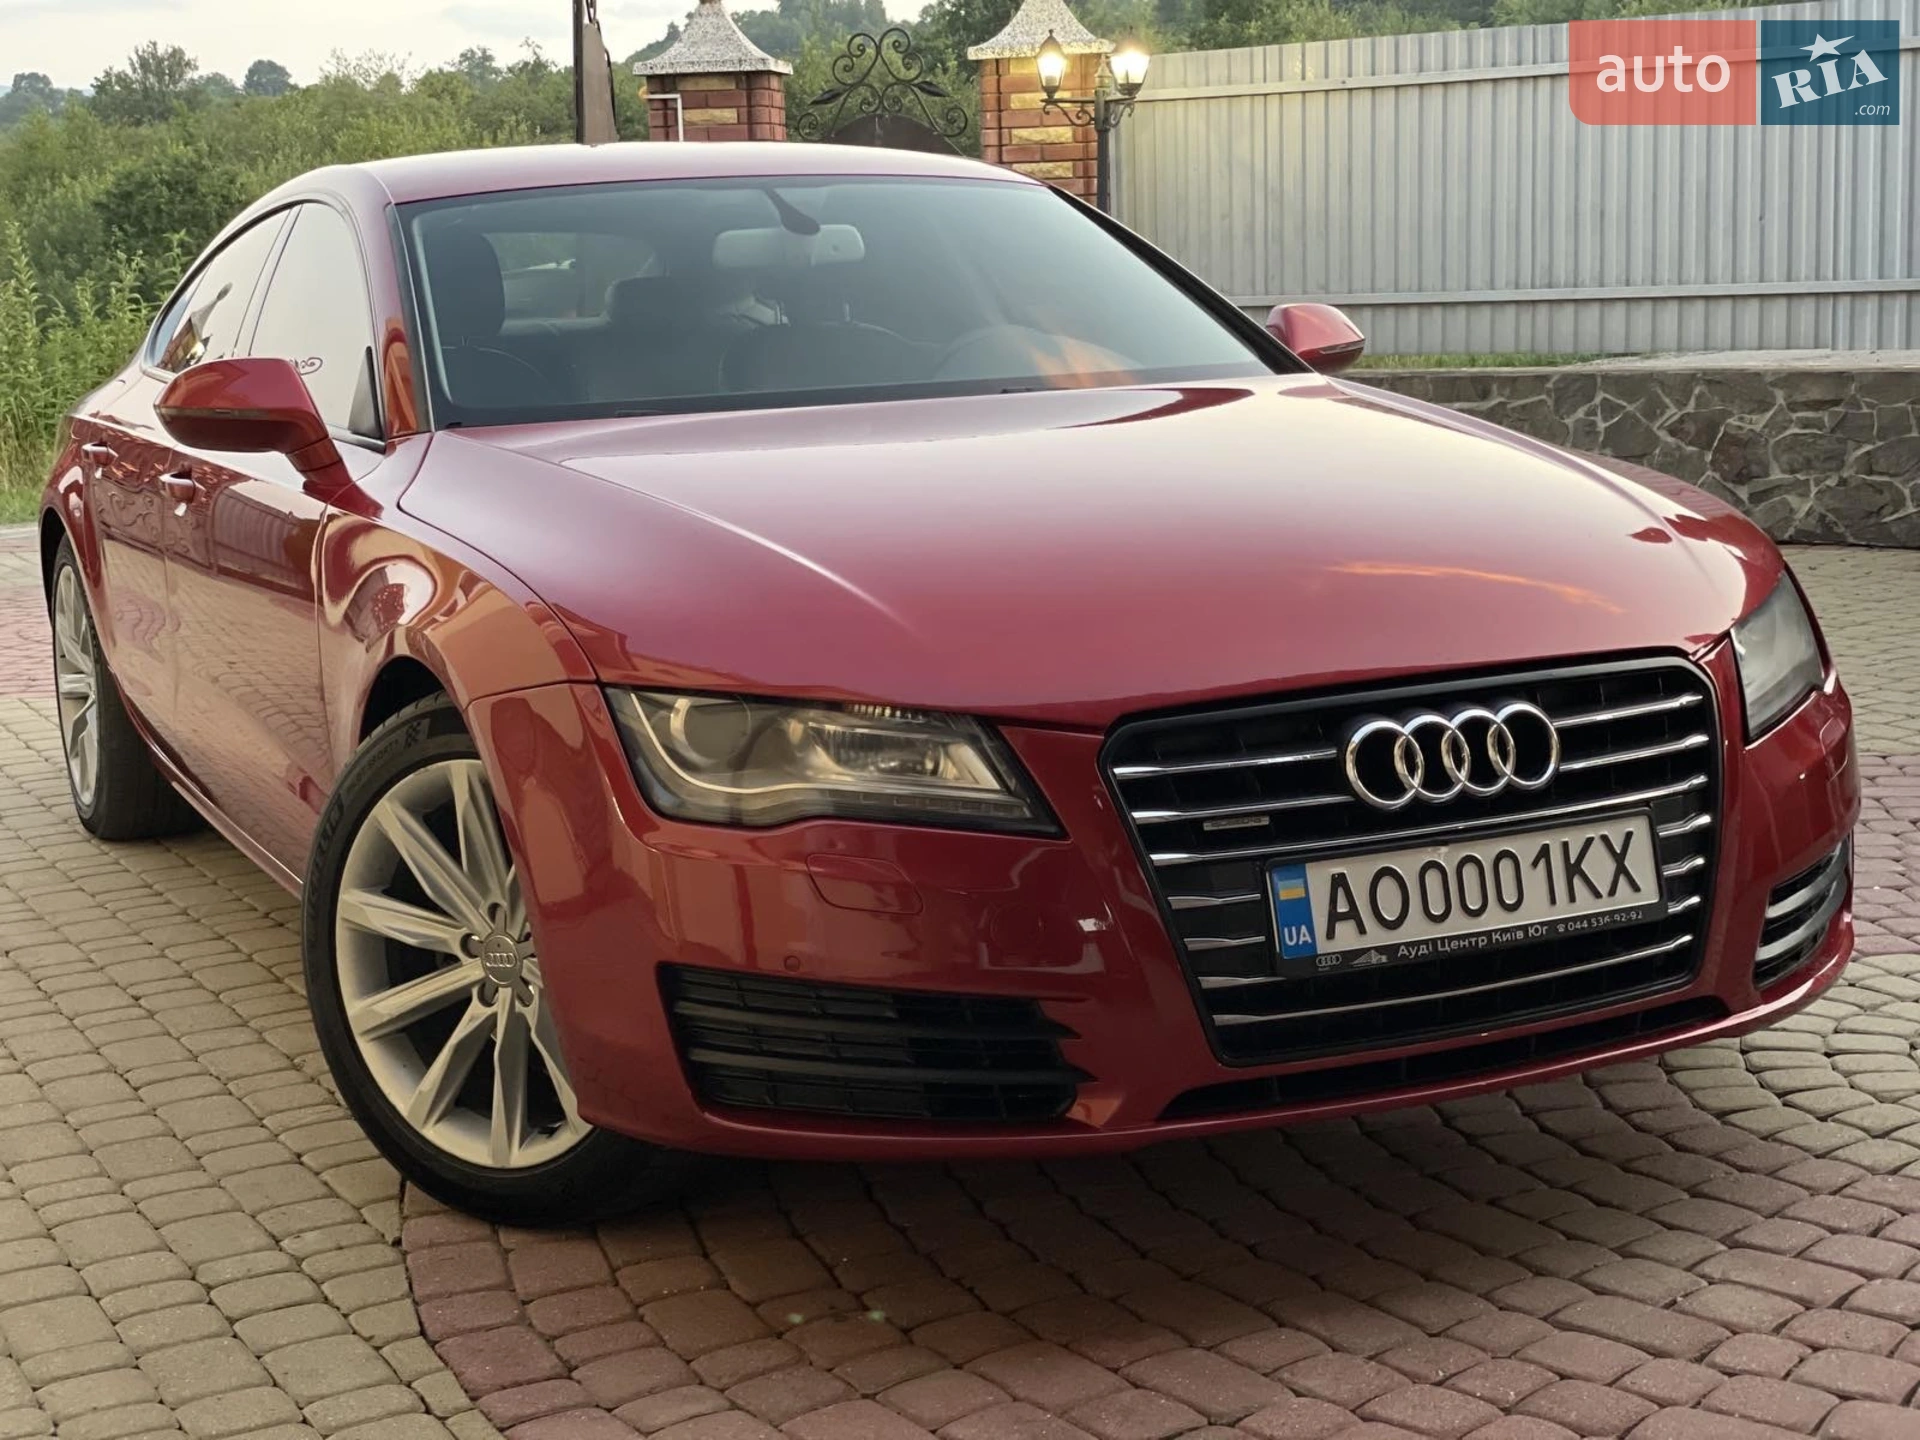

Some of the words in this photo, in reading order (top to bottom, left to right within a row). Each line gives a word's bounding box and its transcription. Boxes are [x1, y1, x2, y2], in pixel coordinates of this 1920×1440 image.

[1284, 925, 1312, 946] UA
[1397, 943, 1433, 959] Ауді
[1437, 936, 1488, 953] Центр
[1492, 928, 1525, 944] Київ
[1528, 924, 1549, 938] Юг
